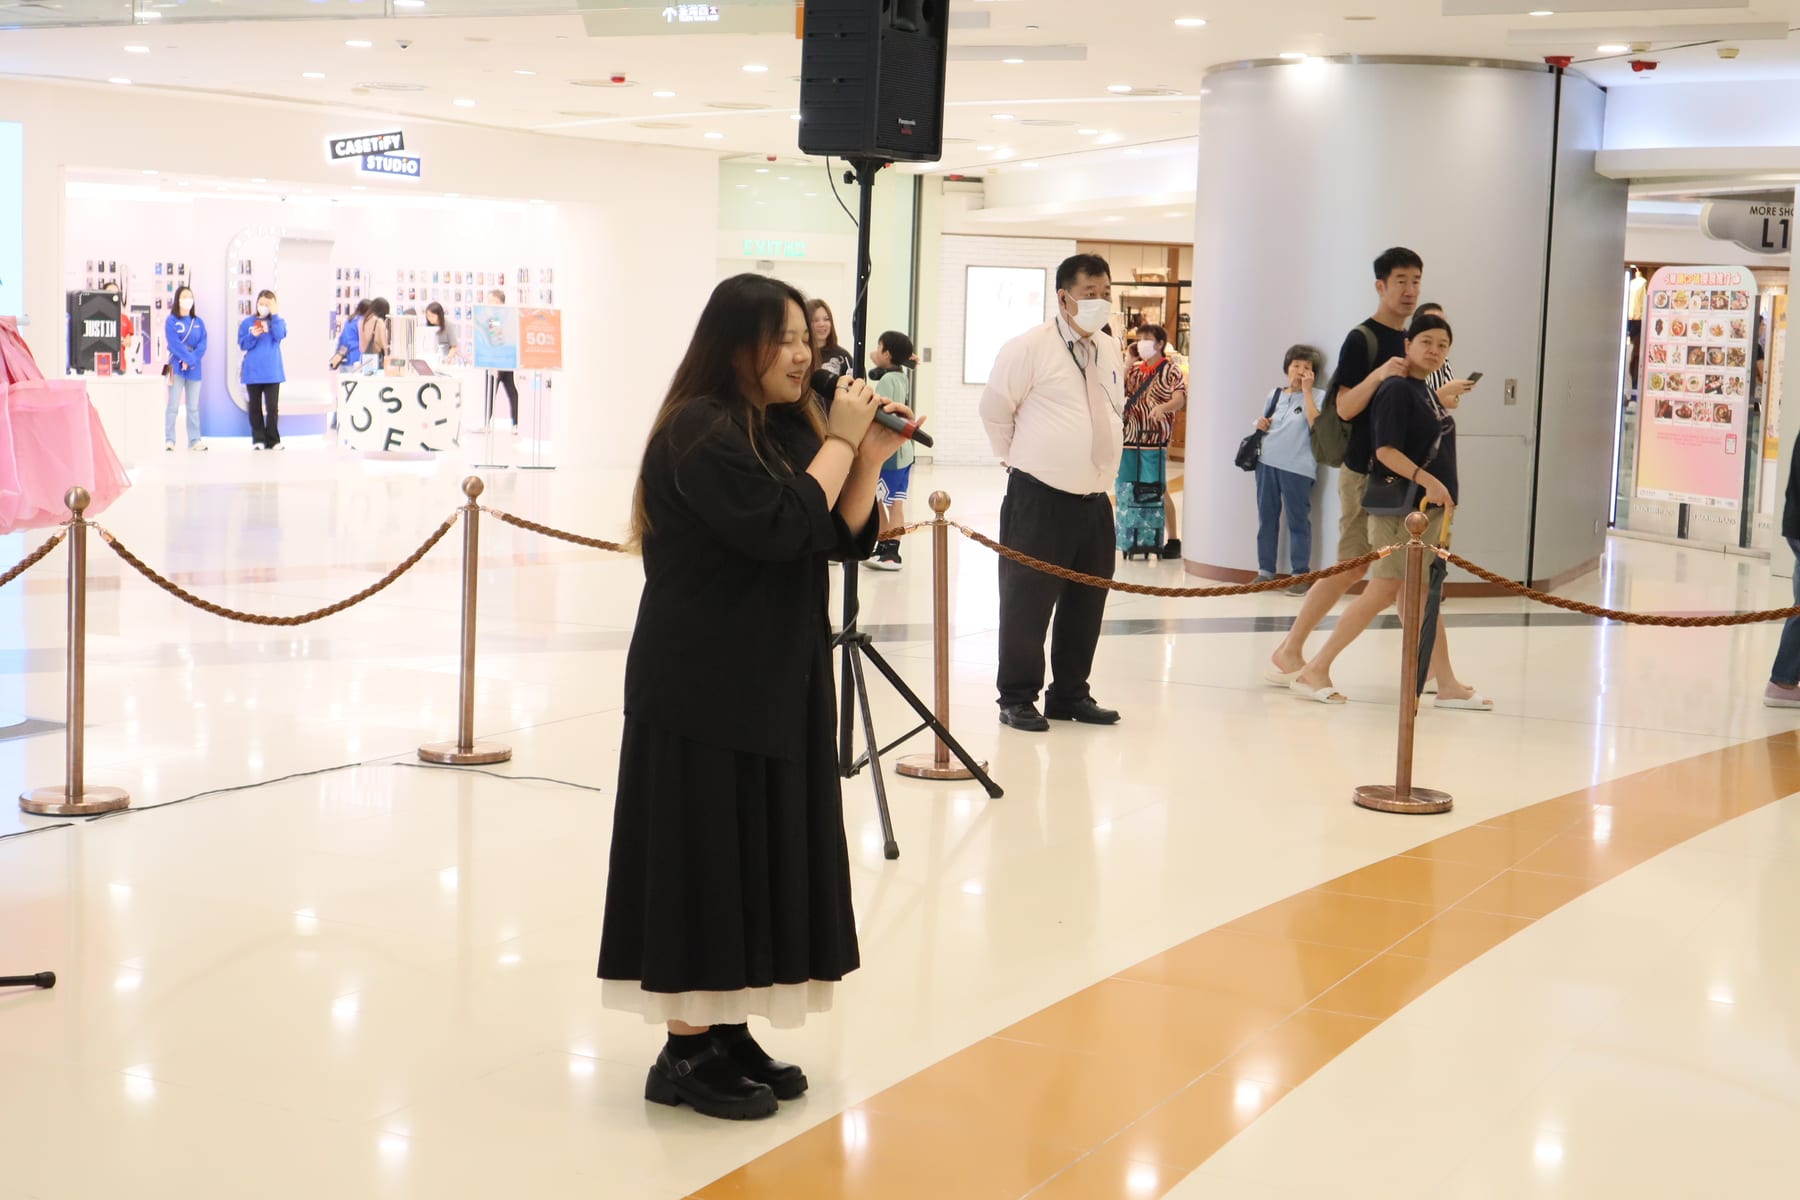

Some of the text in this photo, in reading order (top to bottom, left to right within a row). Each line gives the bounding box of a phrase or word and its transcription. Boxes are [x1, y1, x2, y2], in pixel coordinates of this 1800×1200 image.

[1749, 206, 1777, 216] MORE
[1761, 217, 1790, 249] L1
[743, 239, 781, 257] EXIT
[82, 319, 117, 338] JUSTIN
